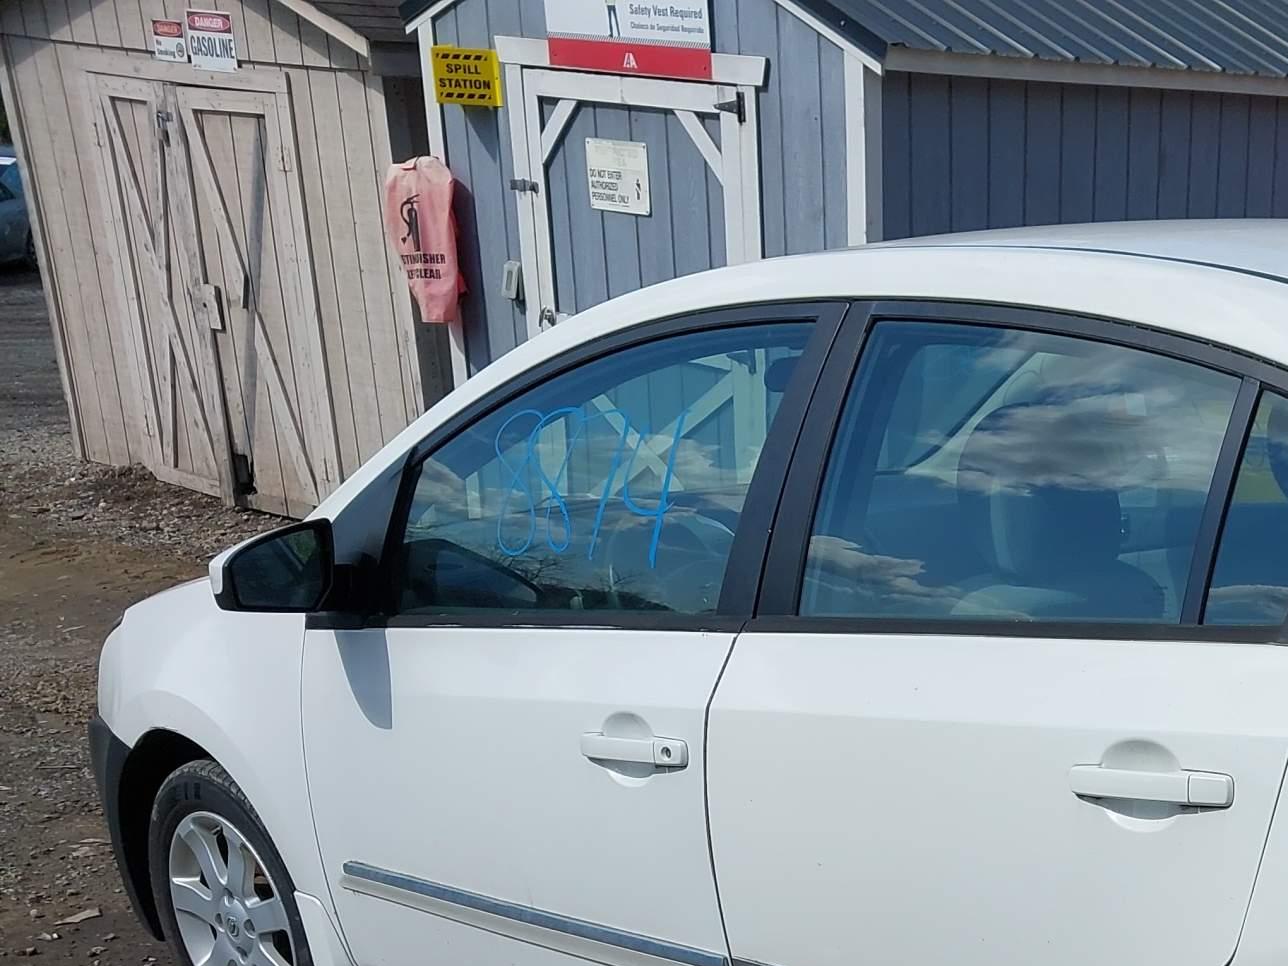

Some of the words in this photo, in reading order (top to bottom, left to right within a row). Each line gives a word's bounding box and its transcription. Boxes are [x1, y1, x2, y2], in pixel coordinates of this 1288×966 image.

[629, 3, 651, 18] Safety
[652, 5, 668, 17] Vest
[669, 6, 703, 21] Required
[194, 16, 223, 29] DANGER
[190, 35, 235, 59] GASOLINE
[446, 63, 481, 75] SPILL
[439, 77, 491, 90] STATION
[589, 168, 597, 178] DO
[597, 169, 606, 179] NOT
[495, 406, 691, 569] 8874
